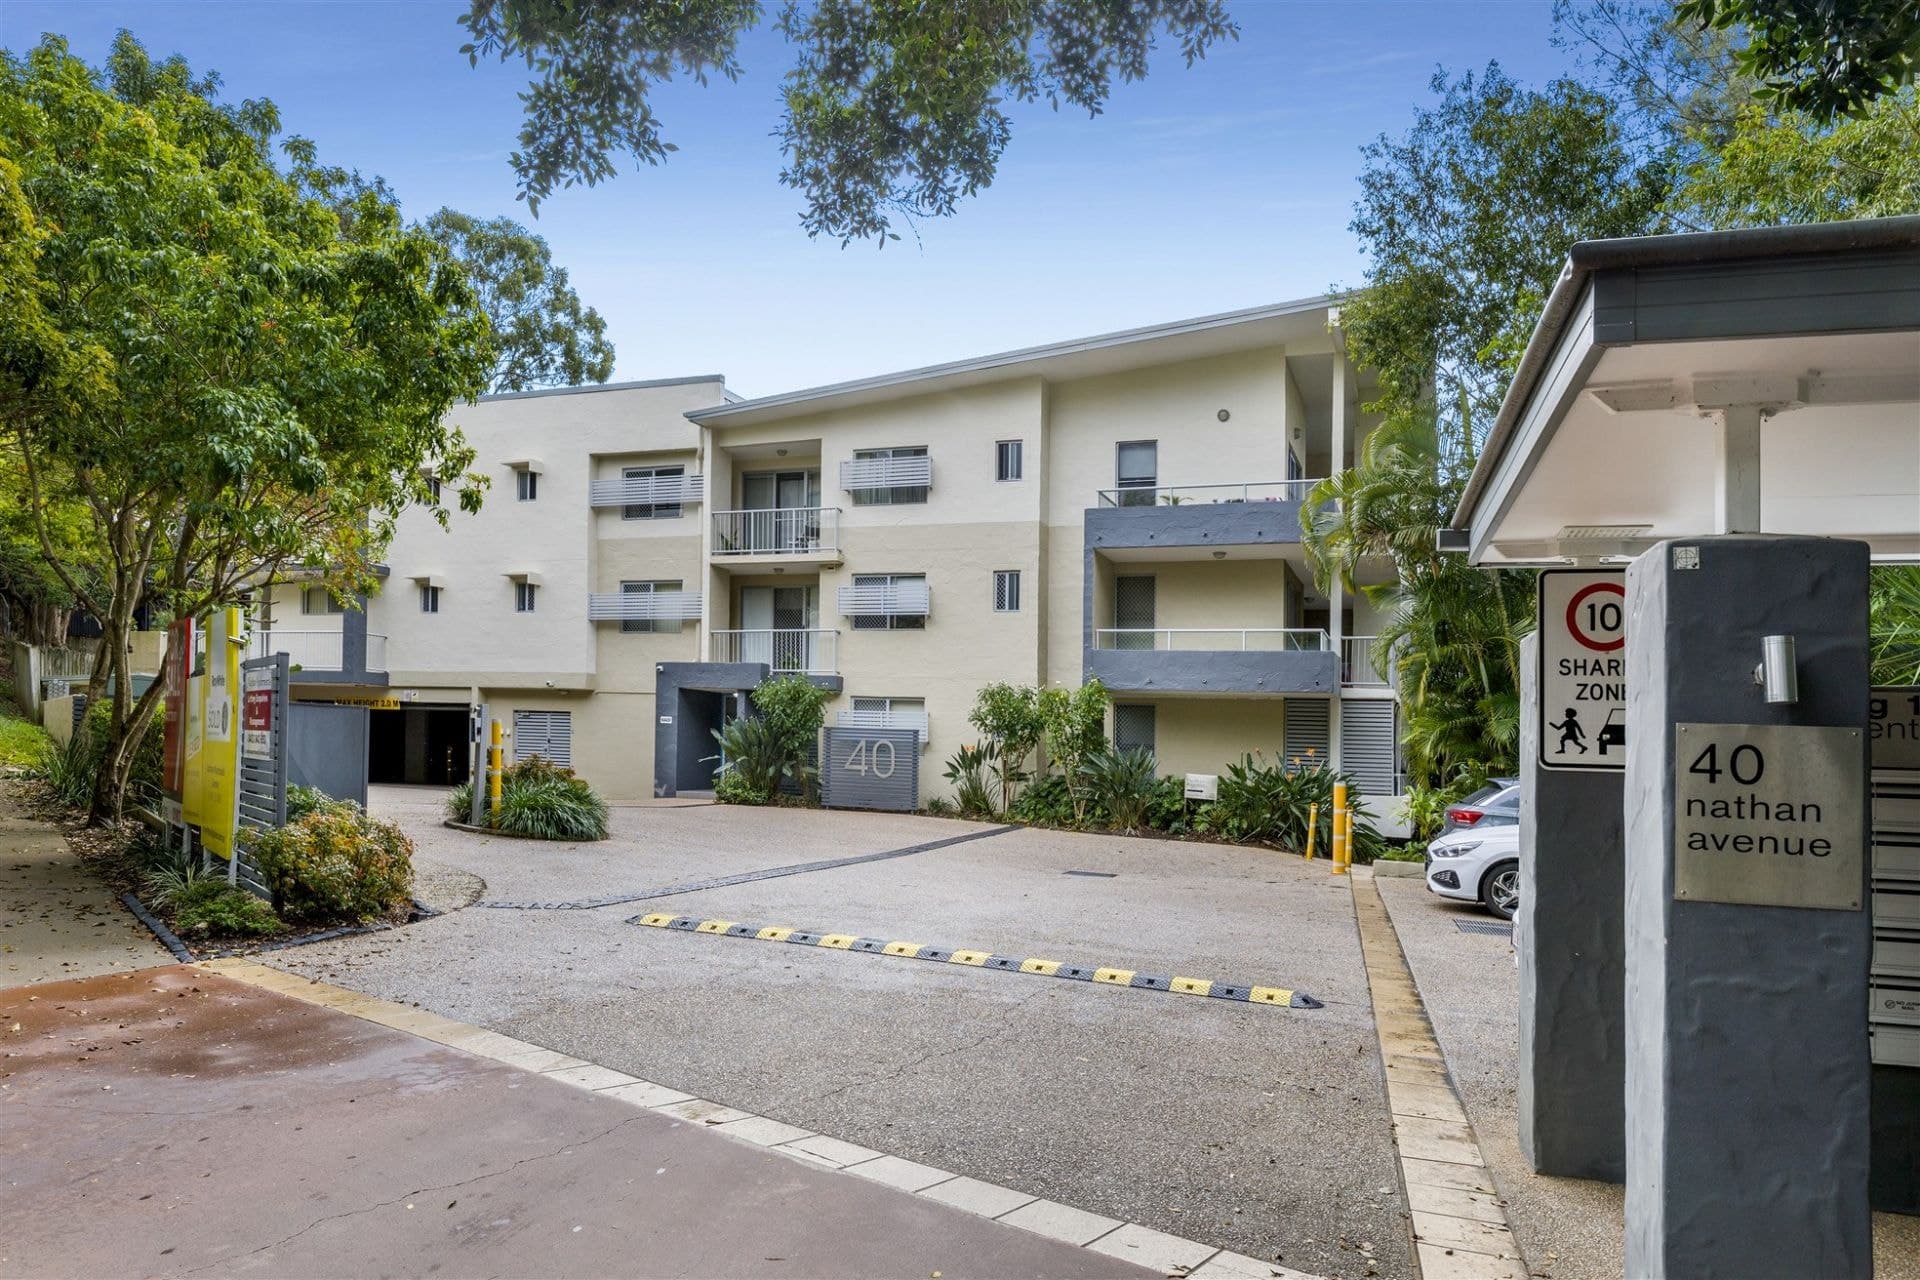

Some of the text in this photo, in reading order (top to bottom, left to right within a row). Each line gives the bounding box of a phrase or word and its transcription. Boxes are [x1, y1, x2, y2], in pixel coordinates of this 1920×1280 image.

[1587, 603, 1621, 631] 10
[1559, 658, 1625, 676] SHAR
[353, 697, 379, 708] HEIGHT
[844, 739, 895, 778] 40
[1689, 743, 1765, 785] 40
[1686, 793, 1821, 823] nathan
[1687, 832, 1832, 857] avenue
